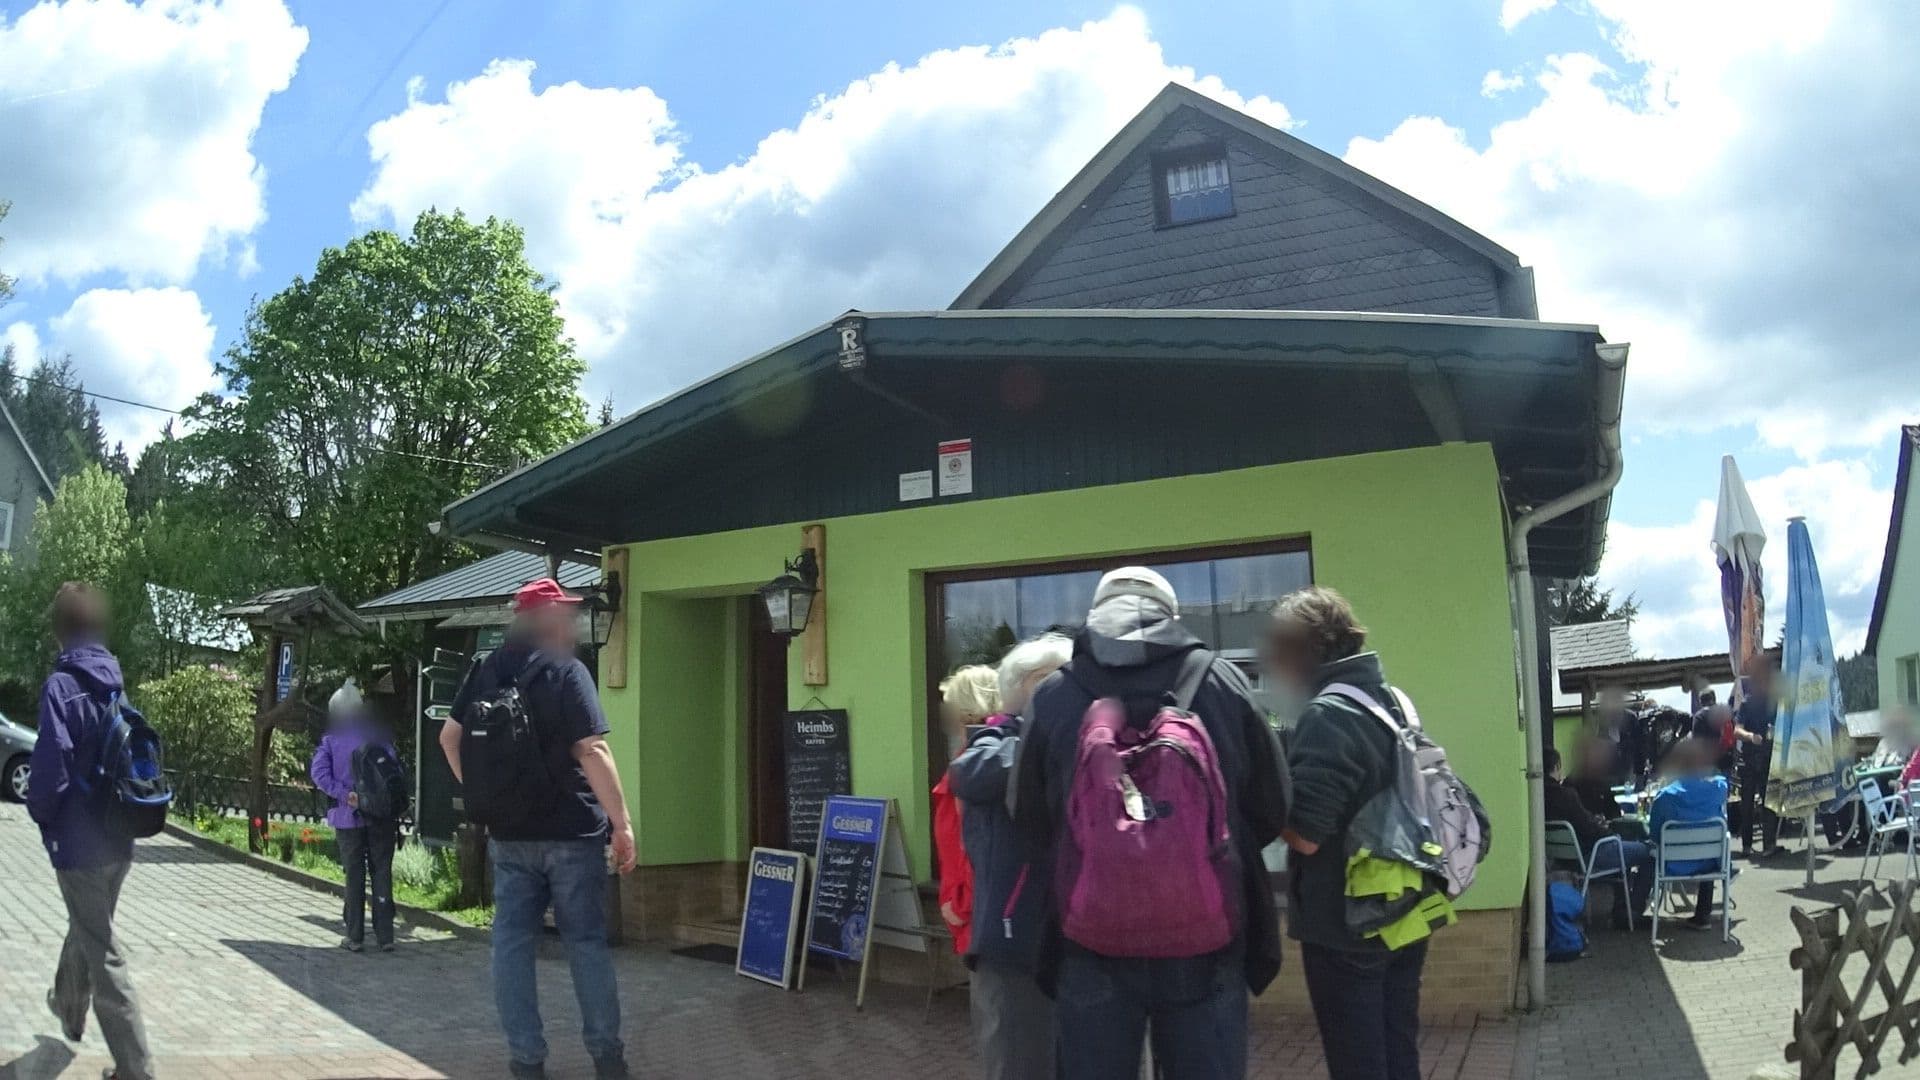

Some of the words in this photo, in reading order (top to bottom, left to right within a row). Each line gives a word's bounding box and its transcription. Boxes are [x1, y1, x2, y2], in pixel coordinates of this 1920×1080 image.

[842, 329, 858, 351] R
[282, 645, 291, 676] P
[797, 720, 834, 733] Heimbs
[832, 815, 874, 833] GESSNER
[754, 861, 795, 883] GESSNER
